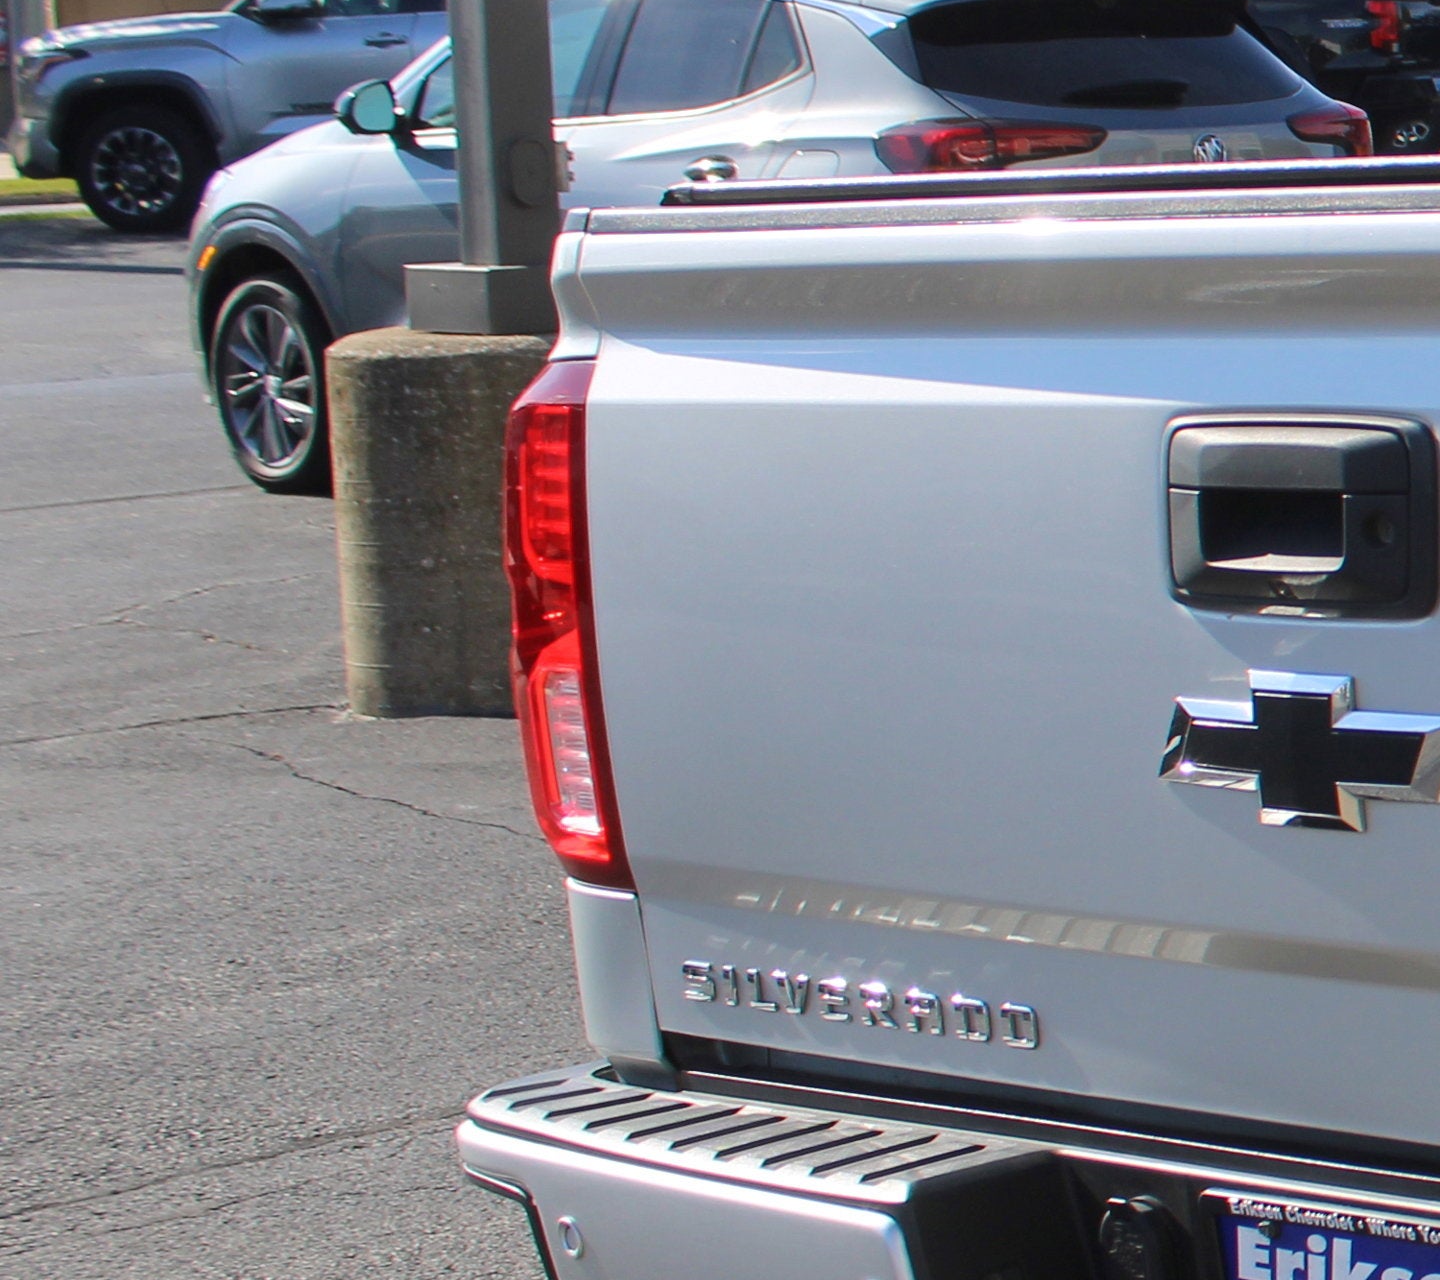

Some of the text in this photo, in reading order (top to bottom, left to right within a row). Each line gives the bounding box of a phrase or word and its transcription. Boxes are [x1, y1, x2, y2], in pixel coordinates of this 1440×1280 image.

[682, 960, 1040, 1050] SILVERADO
[1228, 1198, 1283, 1221] Eriksen
[1286, 1206, 1354, 1232] Chevrolet
[1366, 1218, 1416, 1241] Where
